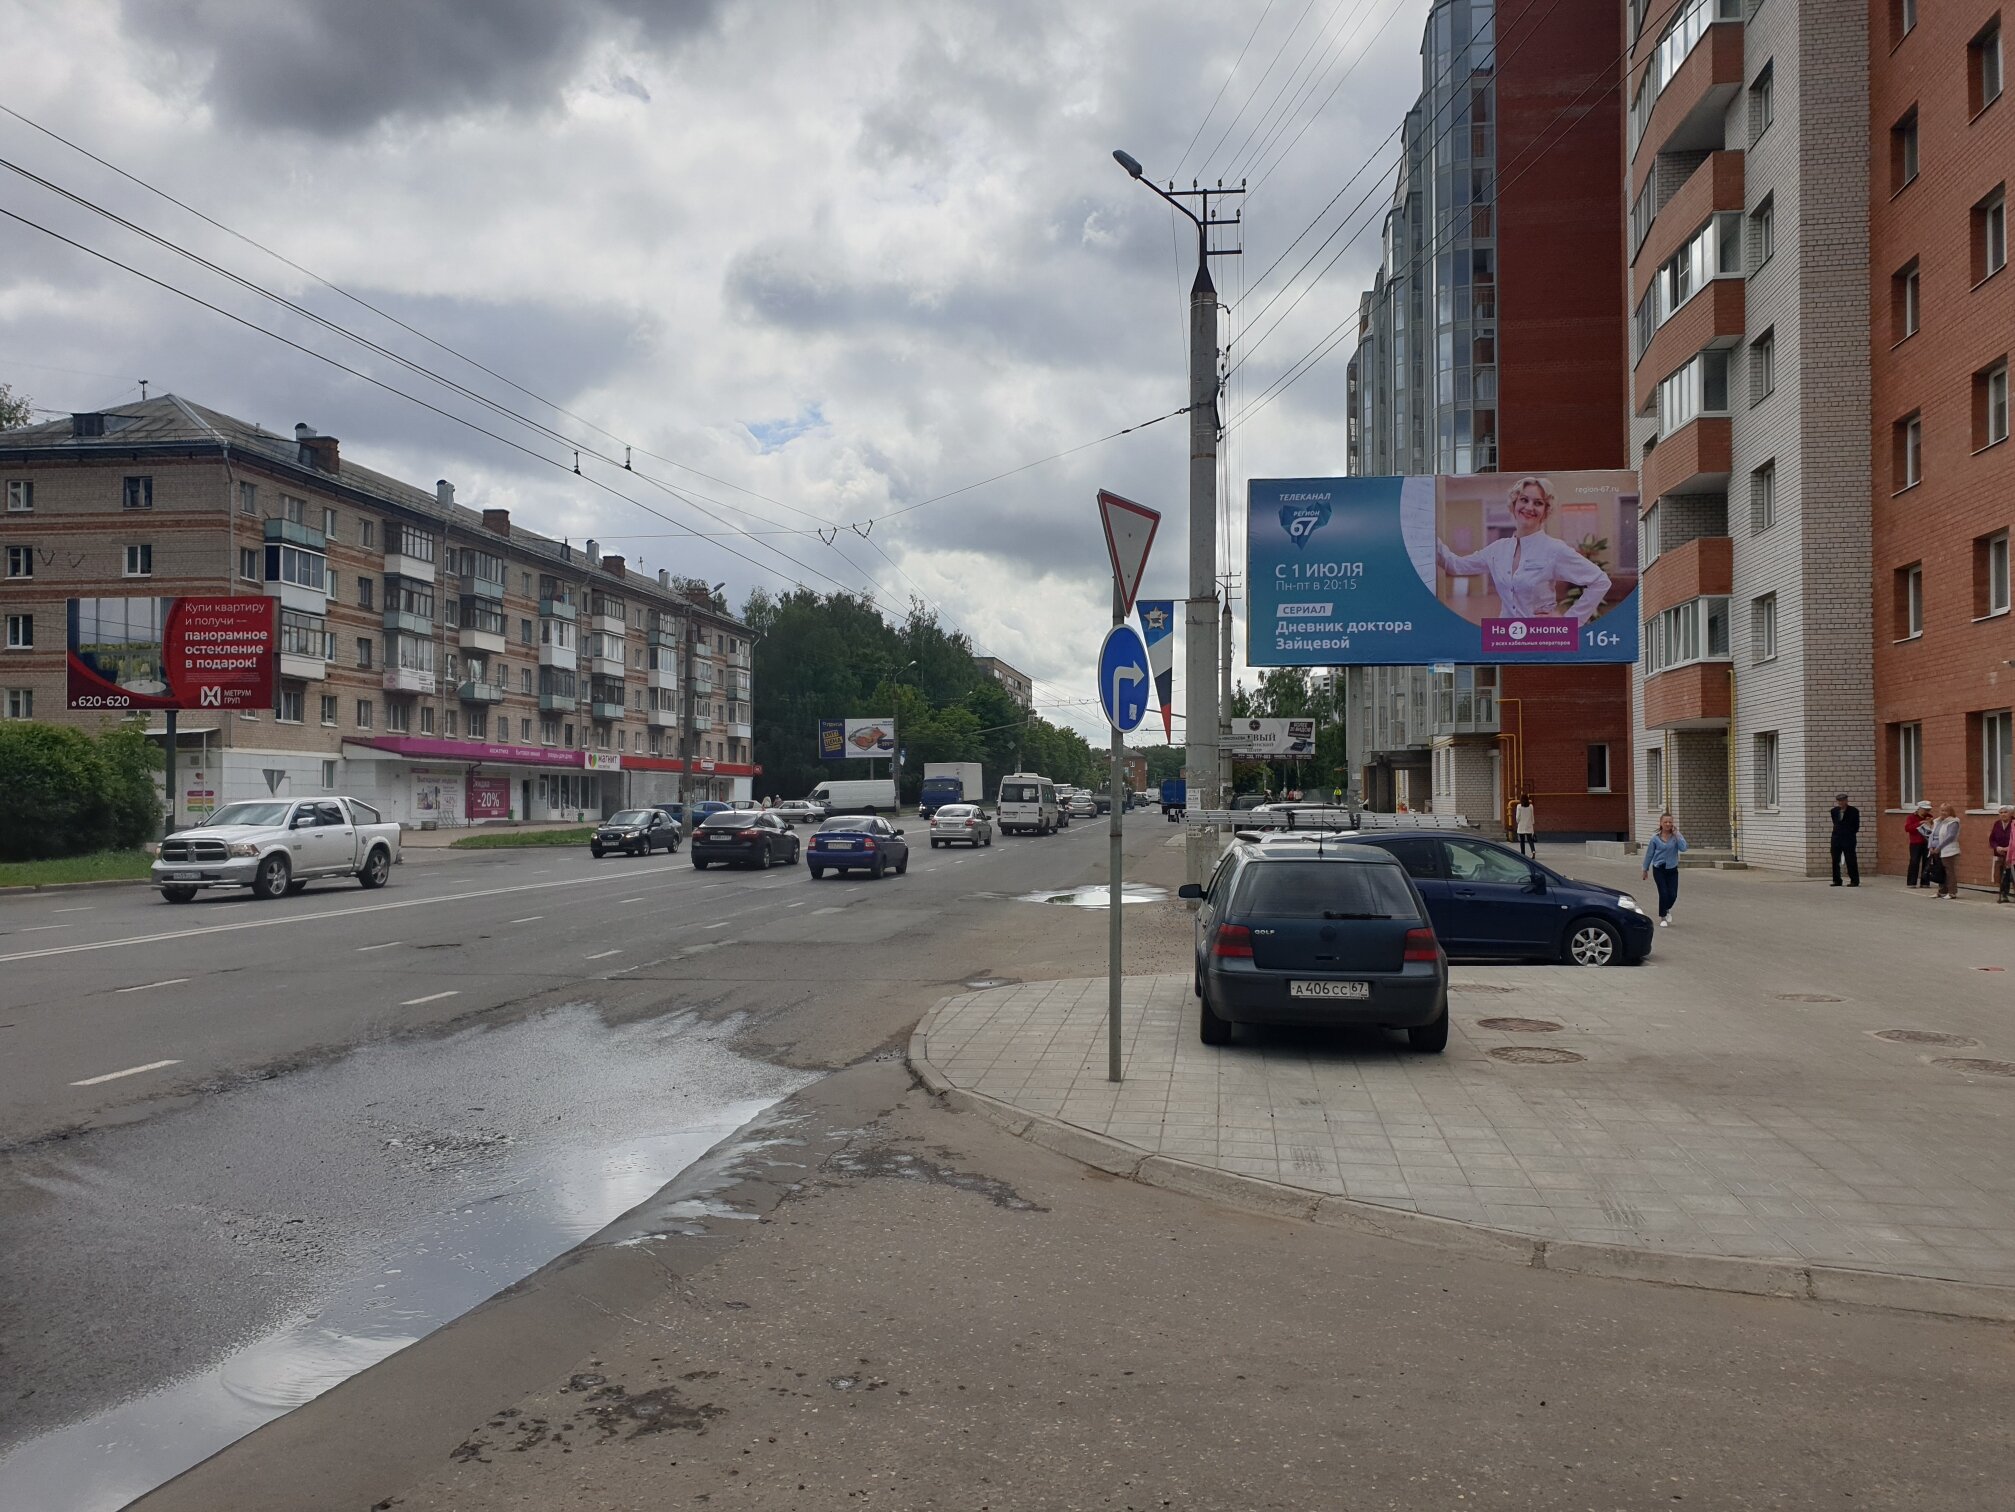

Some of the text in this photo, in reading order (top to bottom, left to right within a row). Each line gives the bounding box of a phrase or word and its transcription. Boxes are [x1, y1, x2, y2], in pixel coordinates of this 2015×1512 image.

[1280, 493, 1331, 501] ТЕЛЕКАНАЛ
[1290, 517, 1318, 536] 67
[1275, 562, 1363, 578] С 1 ИЮЛЯ
[1276, 579, 1357, 591] Пн-пт в 20:15
[185, 602, 265, 614] Купи квартиру
[1283, 605, 1326, 615] СЕРИАЛ
[185, 617, 192, 626] и
[194, 617, 234, 627] получи
[1276, 621, 1412, 635] Дневник доктора
[185, 629, 268, 642] панорамное
[1491, 625, 1568, 635] На 21 кнопке
[1276, 636, 1350, 651] Зайцевой
[1586, 631, 1620, 647] 16+
[185, 643, 264, 655] остекление
[185, 657, 256, 670] в подарок!
[223, 689, 251, 697] МЕТРУМ
[78, 695, 130, 707] 620-620
[477, 792, 500, 807] -20%
